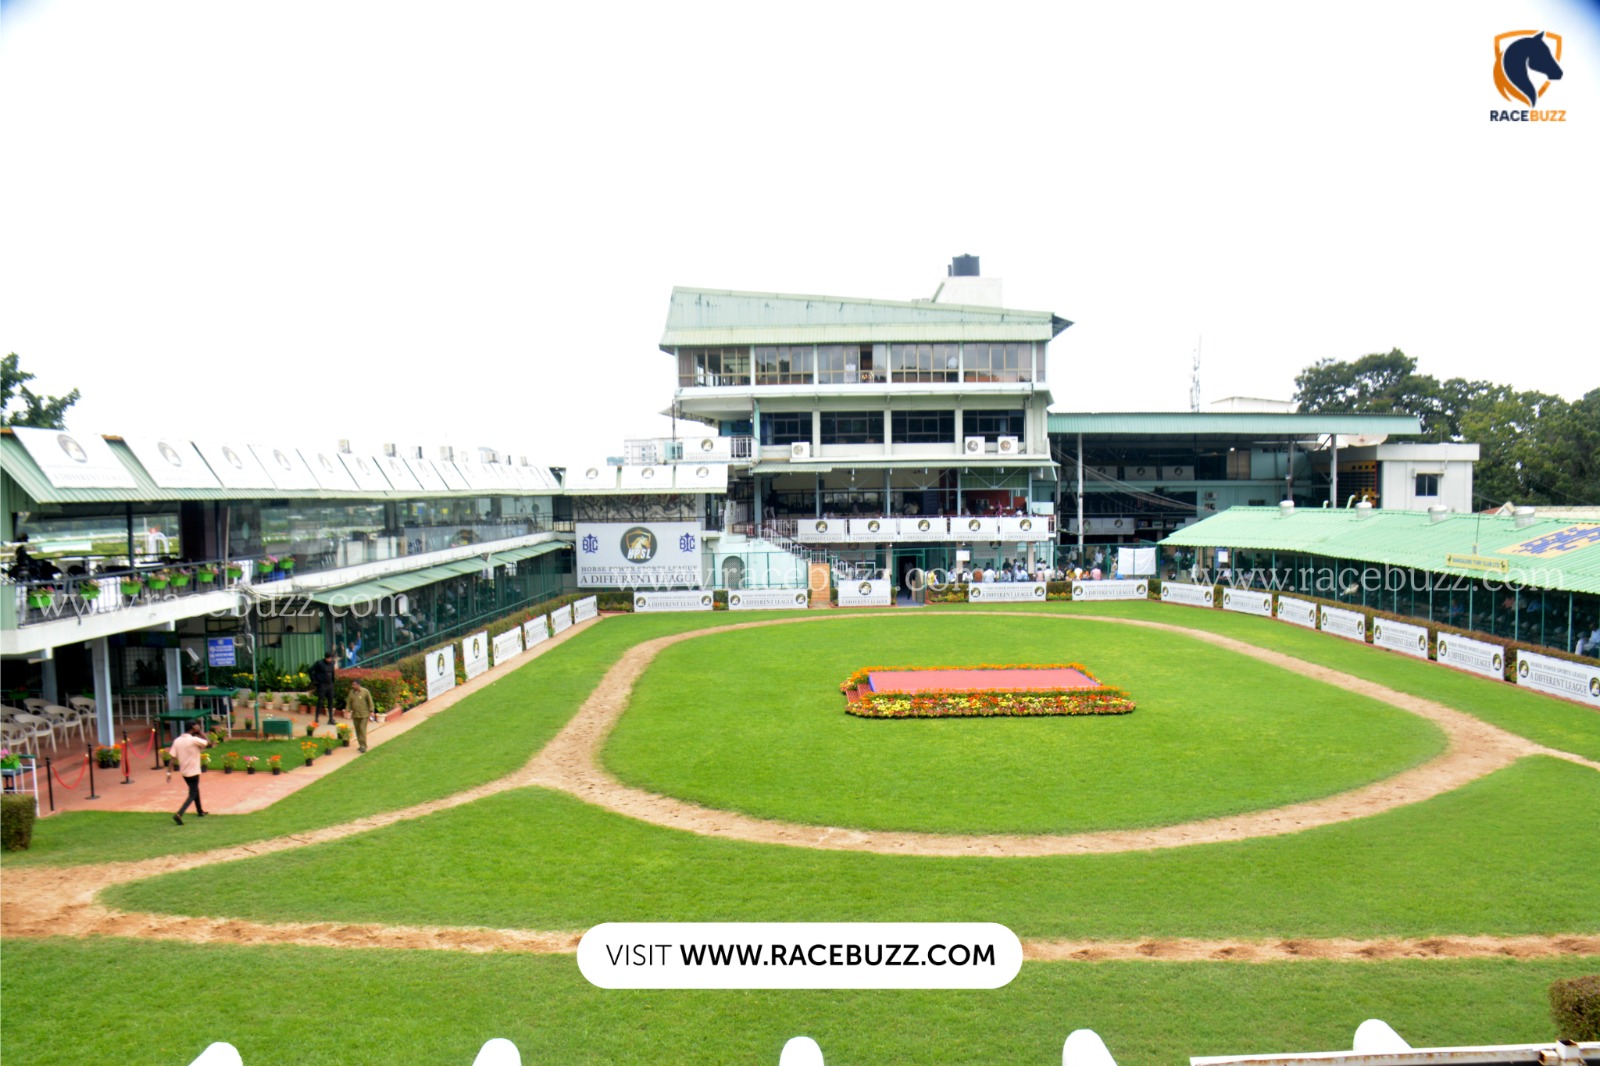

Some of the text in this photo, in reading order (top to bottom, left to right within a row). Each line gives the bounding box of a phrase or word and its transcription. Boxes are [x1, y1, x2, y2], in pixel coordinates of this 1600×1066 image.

[627, 548, 652, 560] HPSL
[580, 574, 698, 584] A DIFFERENT LEAGUE
[1534, 672, 1565, 688] DIFFERENT
[1565, 680, 1587, 694] LEAGUE
